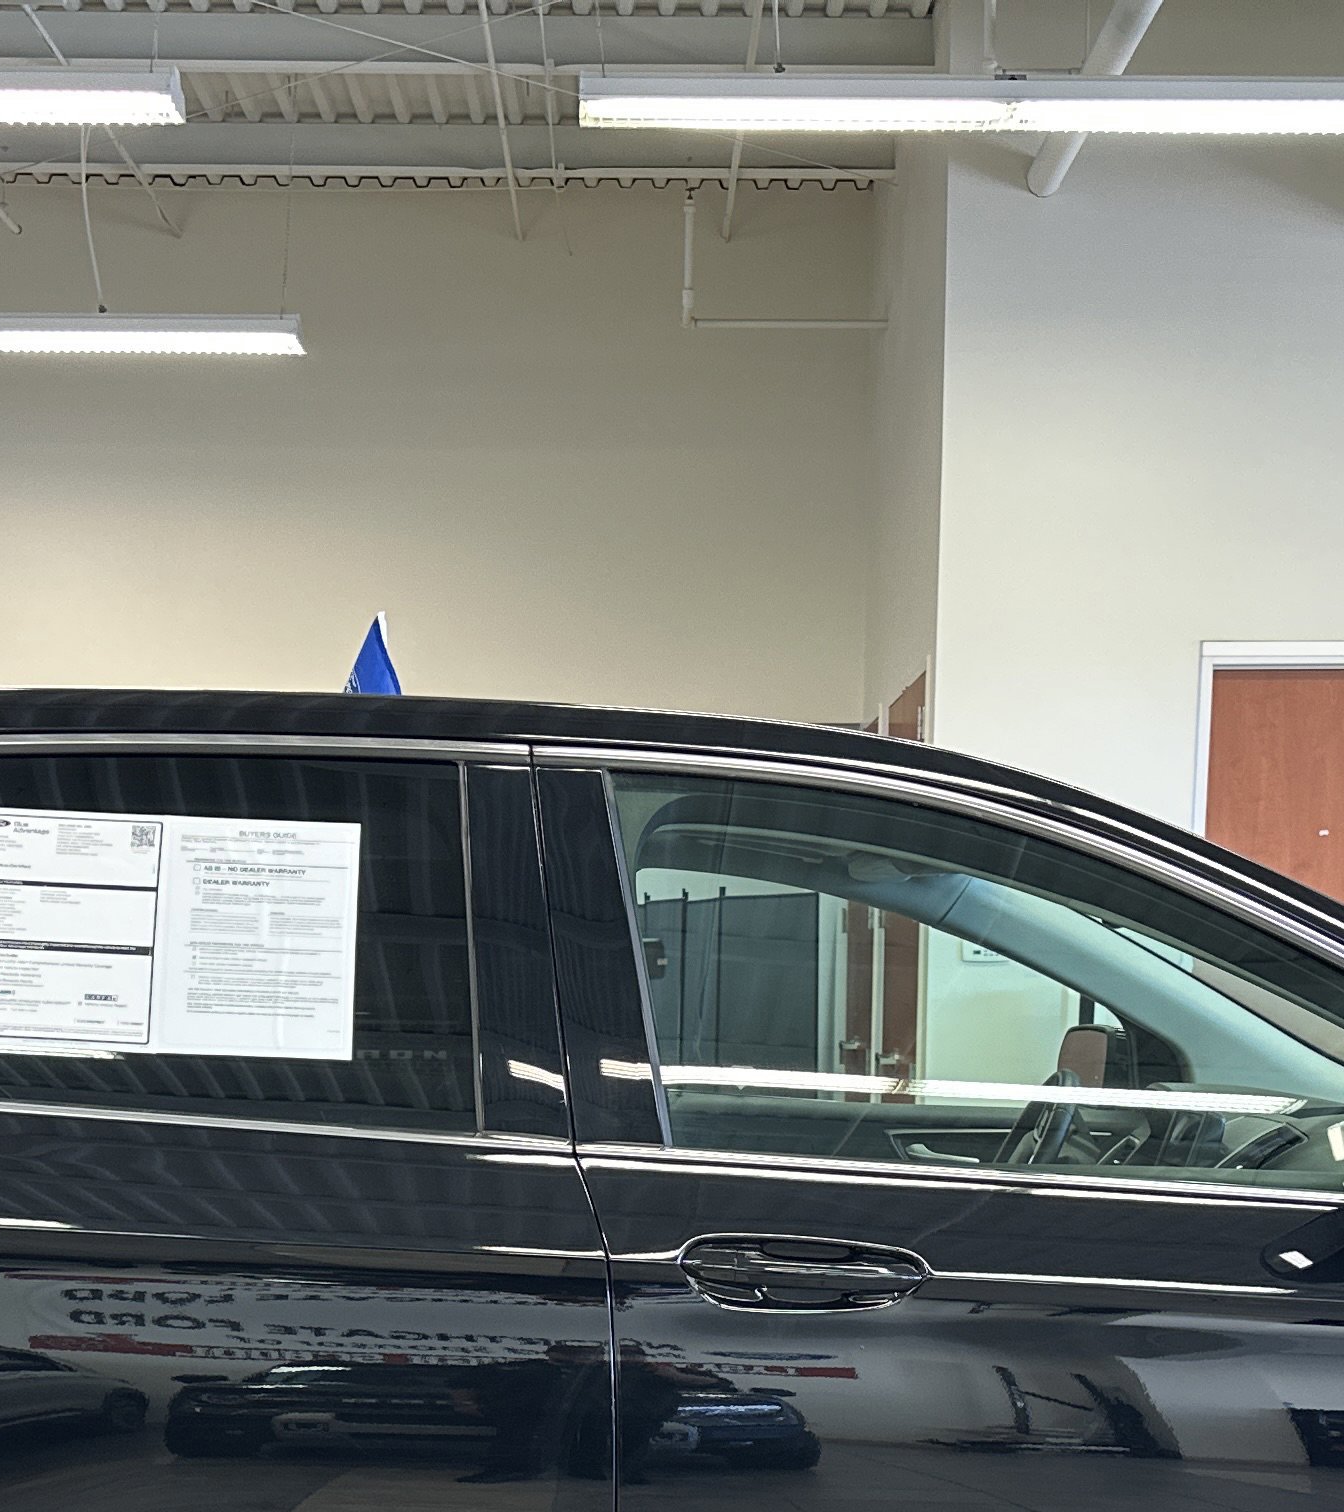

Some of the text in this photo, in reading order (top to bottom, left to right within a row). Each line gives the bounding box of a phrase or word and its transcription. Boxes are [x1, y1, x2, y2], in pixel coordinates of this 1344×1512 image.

[239, 830, 297, 840] BUYERS GUIDE
[267, 868, 306, 876] WARRANTY
[232, 880, 270, 888] WARRANTY
